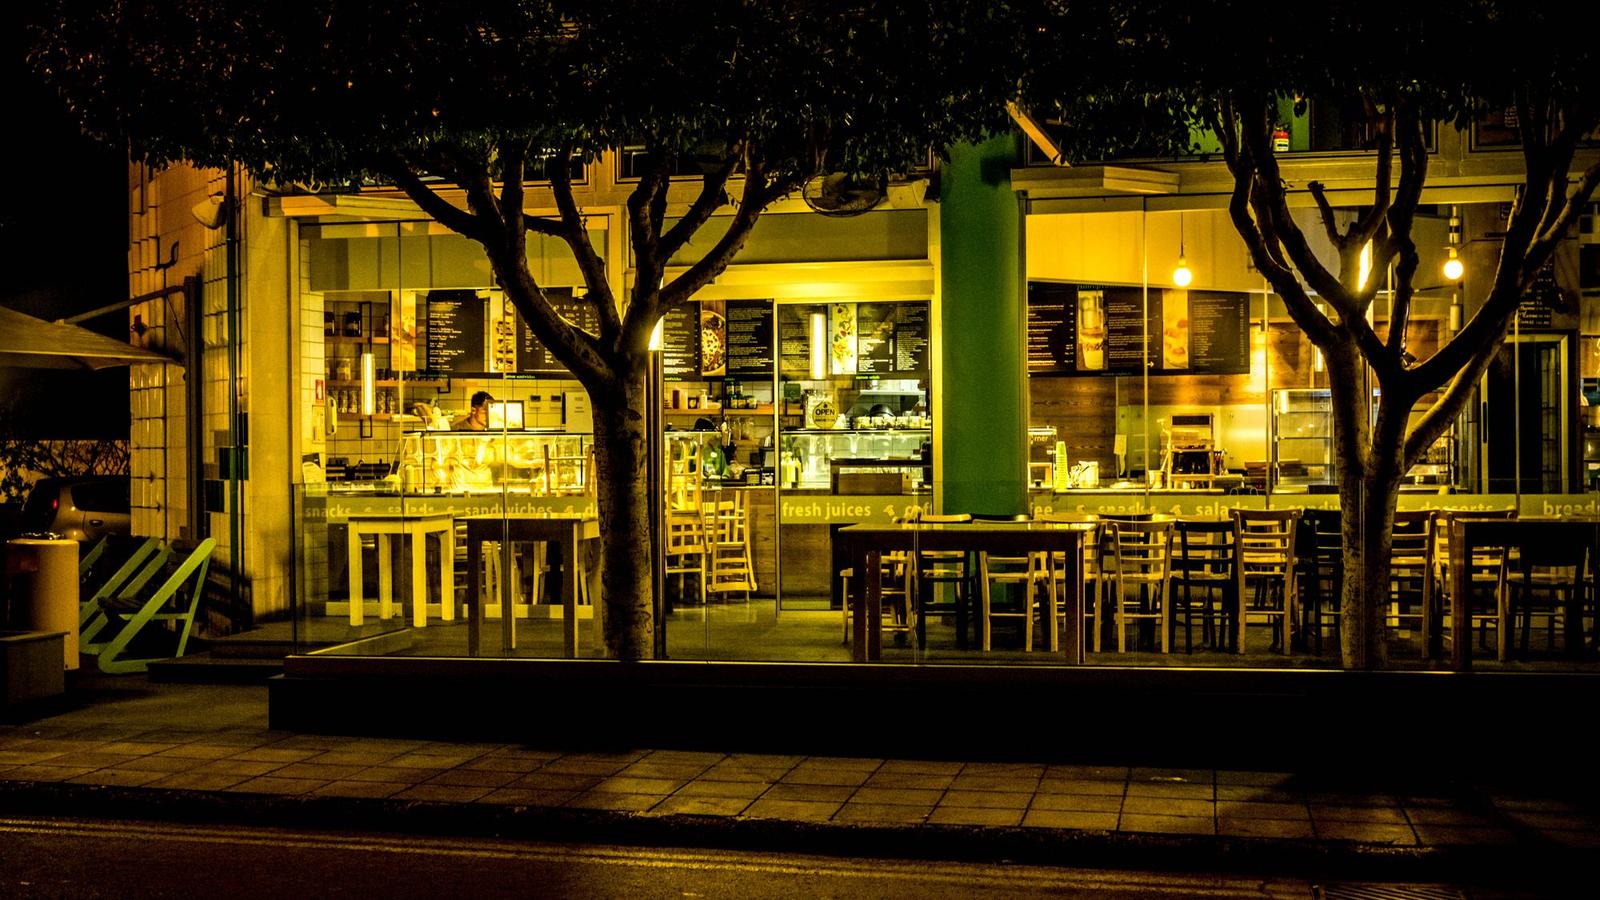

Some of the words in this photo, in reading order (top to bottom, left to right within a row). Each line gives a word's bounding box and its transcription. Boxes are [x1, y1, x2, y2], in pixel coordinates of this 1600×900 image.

[815, 408, 835, 416] OPEN
[305, 504, 350, 518] snacks
[465, 502, 552, 515] sandwiches
[782, 501, 821, 517] fresh
[825, 502, 871, 520] juices
